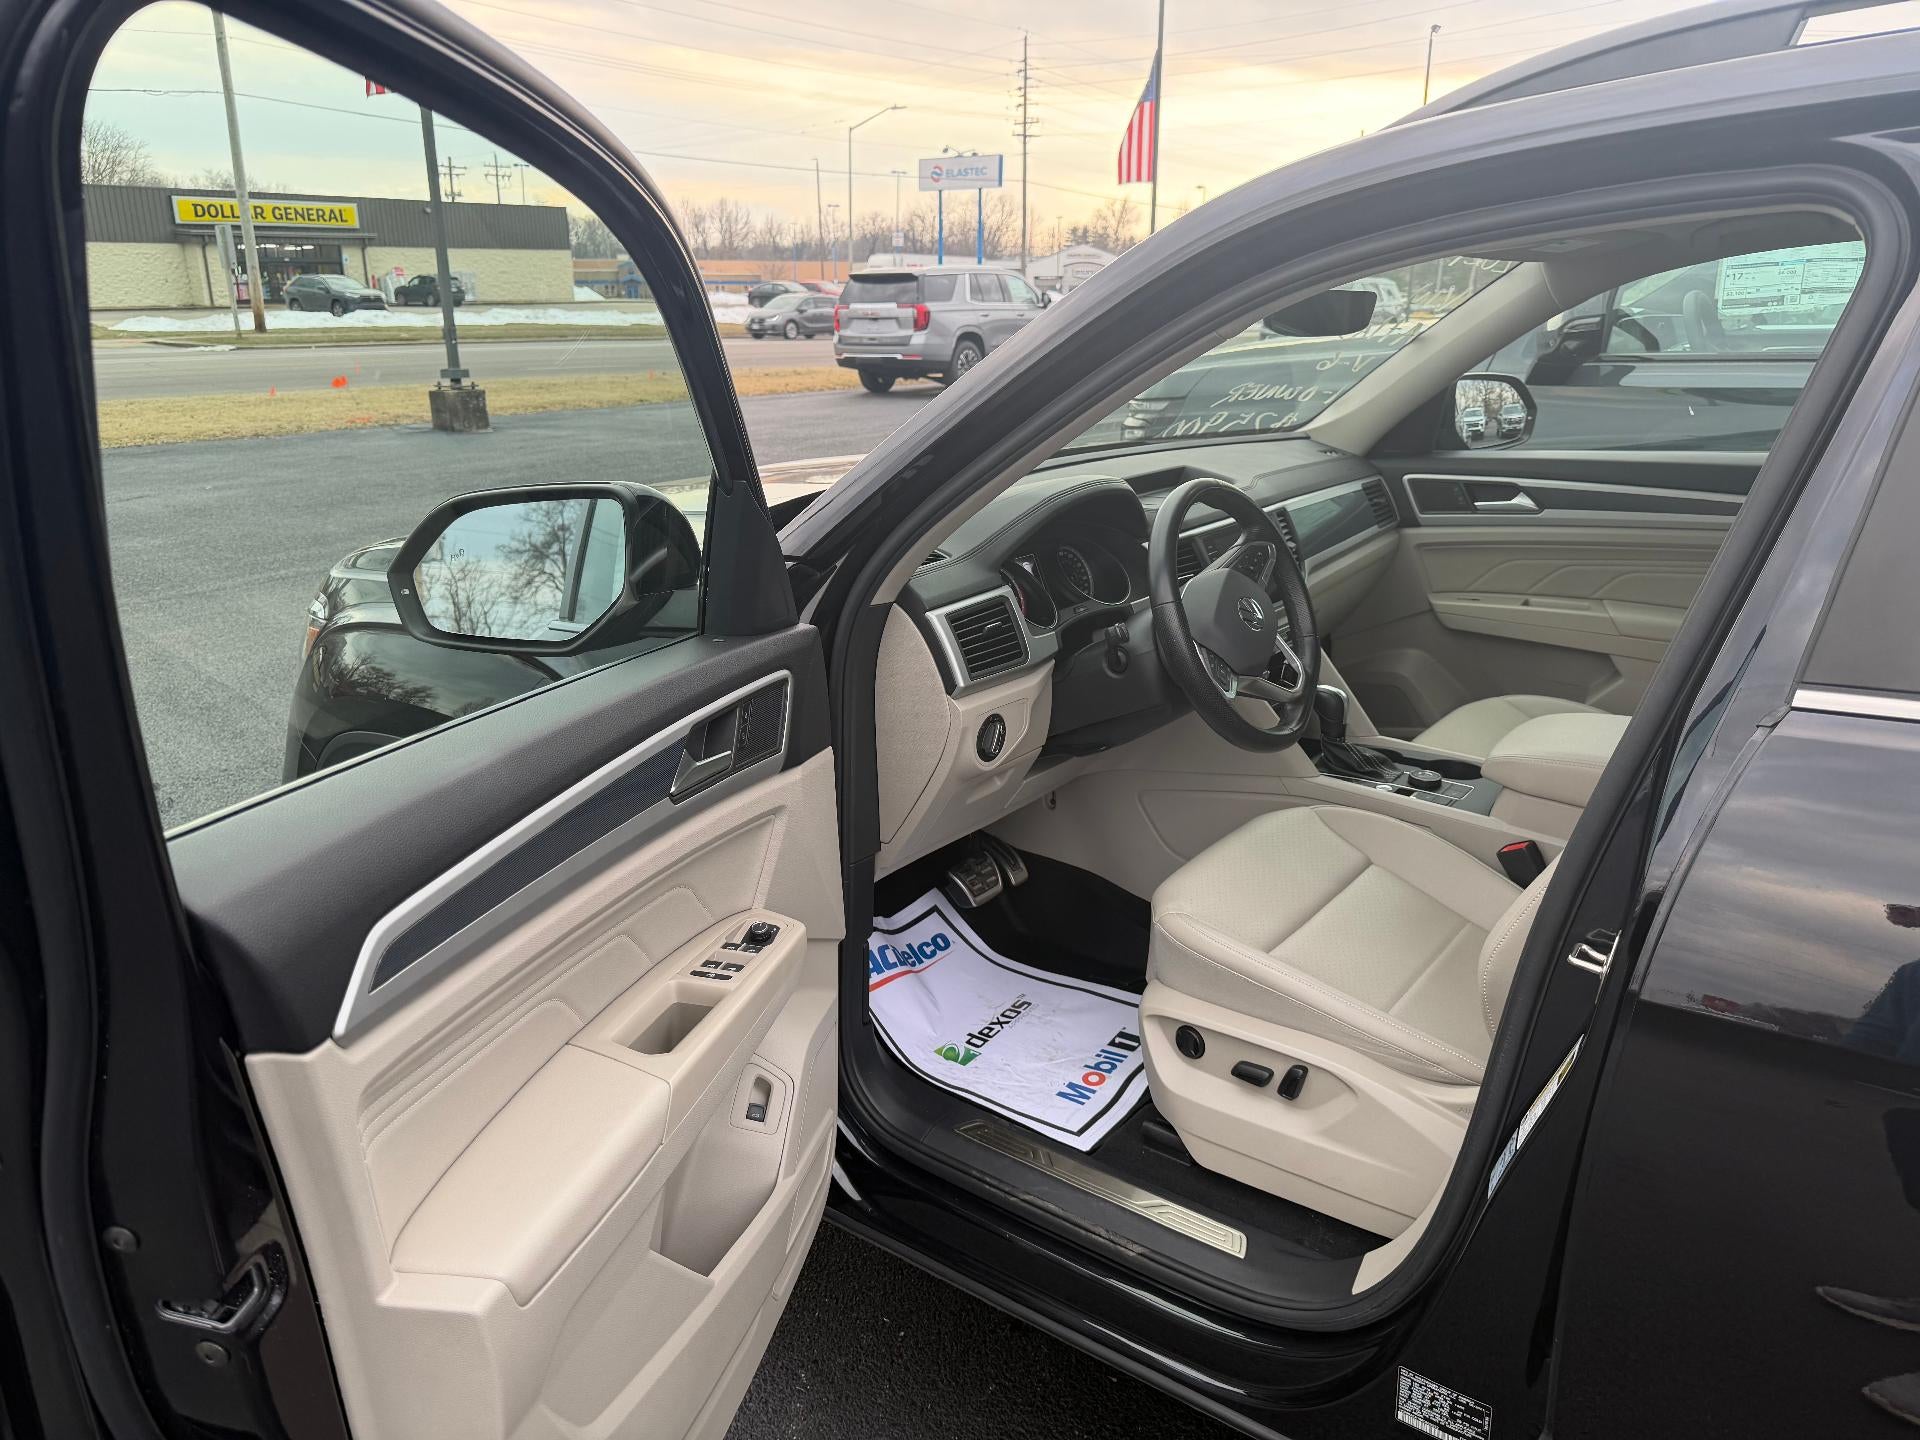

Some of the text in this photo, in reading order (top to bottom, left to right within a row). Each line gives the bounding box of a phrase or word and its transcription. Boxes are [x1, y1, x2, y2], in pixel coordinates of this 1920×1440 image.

[945, 166, 988, 177] ELASTEC
[191, 203, 348, 222] DOLLR GENERAL
[965, 999, 1032, 1049] dexos
[1056, 1049, 1128, 1106] Mobil
